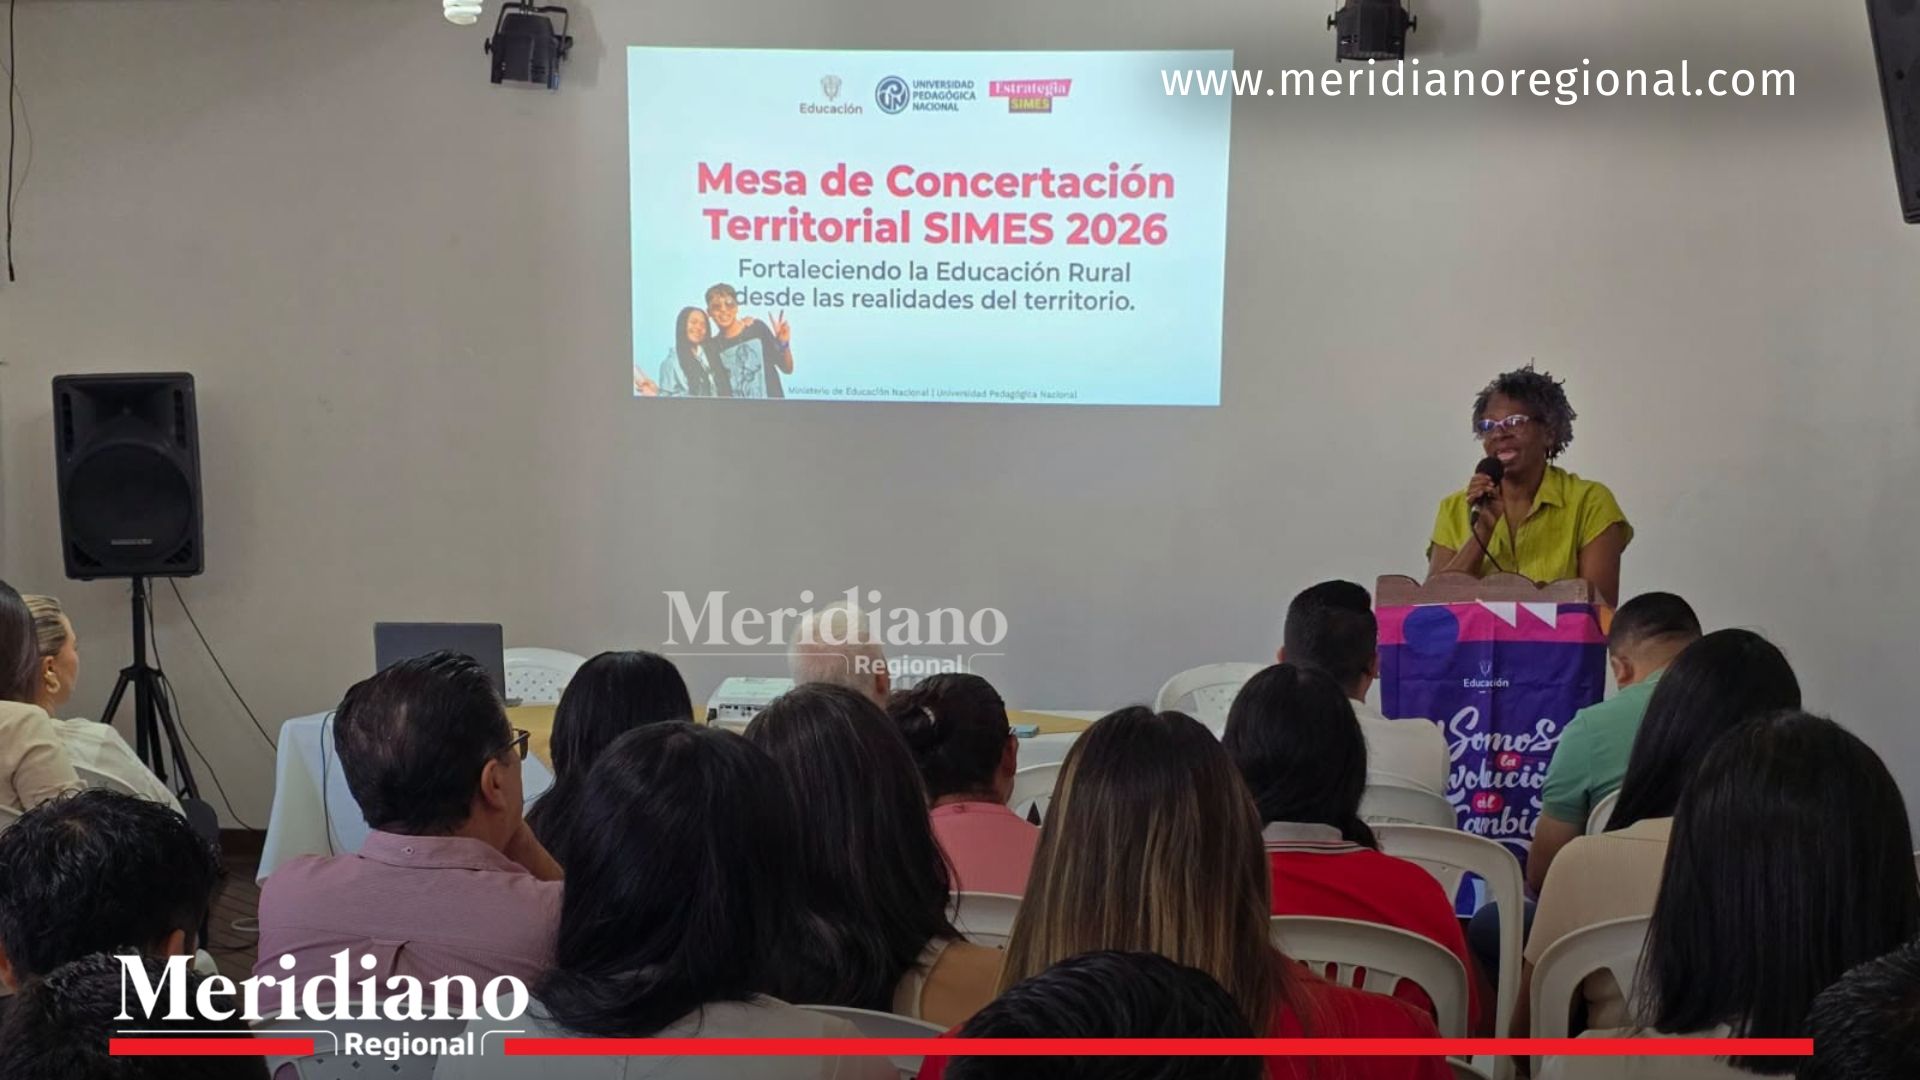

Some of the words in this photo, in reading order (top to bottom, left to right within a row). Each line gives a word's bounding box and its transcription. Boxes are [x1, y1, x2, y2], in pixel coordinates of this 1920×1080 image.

[912, 80, 975, 89] UNIVERSIDAD
[994, 81, 1067, 96] Estrategia
[912, 90, 976, 101] PEDAGÓGICA
[799, 101, 863, 115] Educación
[912, 102, 959, 112] NACIONAL
[697, 163, 806, 195] Mesa
[820, 163, 873, 196] de
[886, 163, 1175, 199] Concertación
[702, 207, 911, 243] Territorial
[923, 212, 1054, 245] SIMES
[1066, 213, 1167, 245] 2026
[738, 258, 902, 281] Fortaleciendo
[909, 260, 928, 280] la
[937, 261, 1061, 282] Educación
[1069, 262, 1131, 282] Rural
[735, 287, 805, 308] desde
[813, 287, 845, 308] las
[852, 288, 974, 310] realidades
[981, 289, 1017, 310] del
[1024, 290, 1136, 311] territorio.
[1463, 677, 1509, 688] Educación
